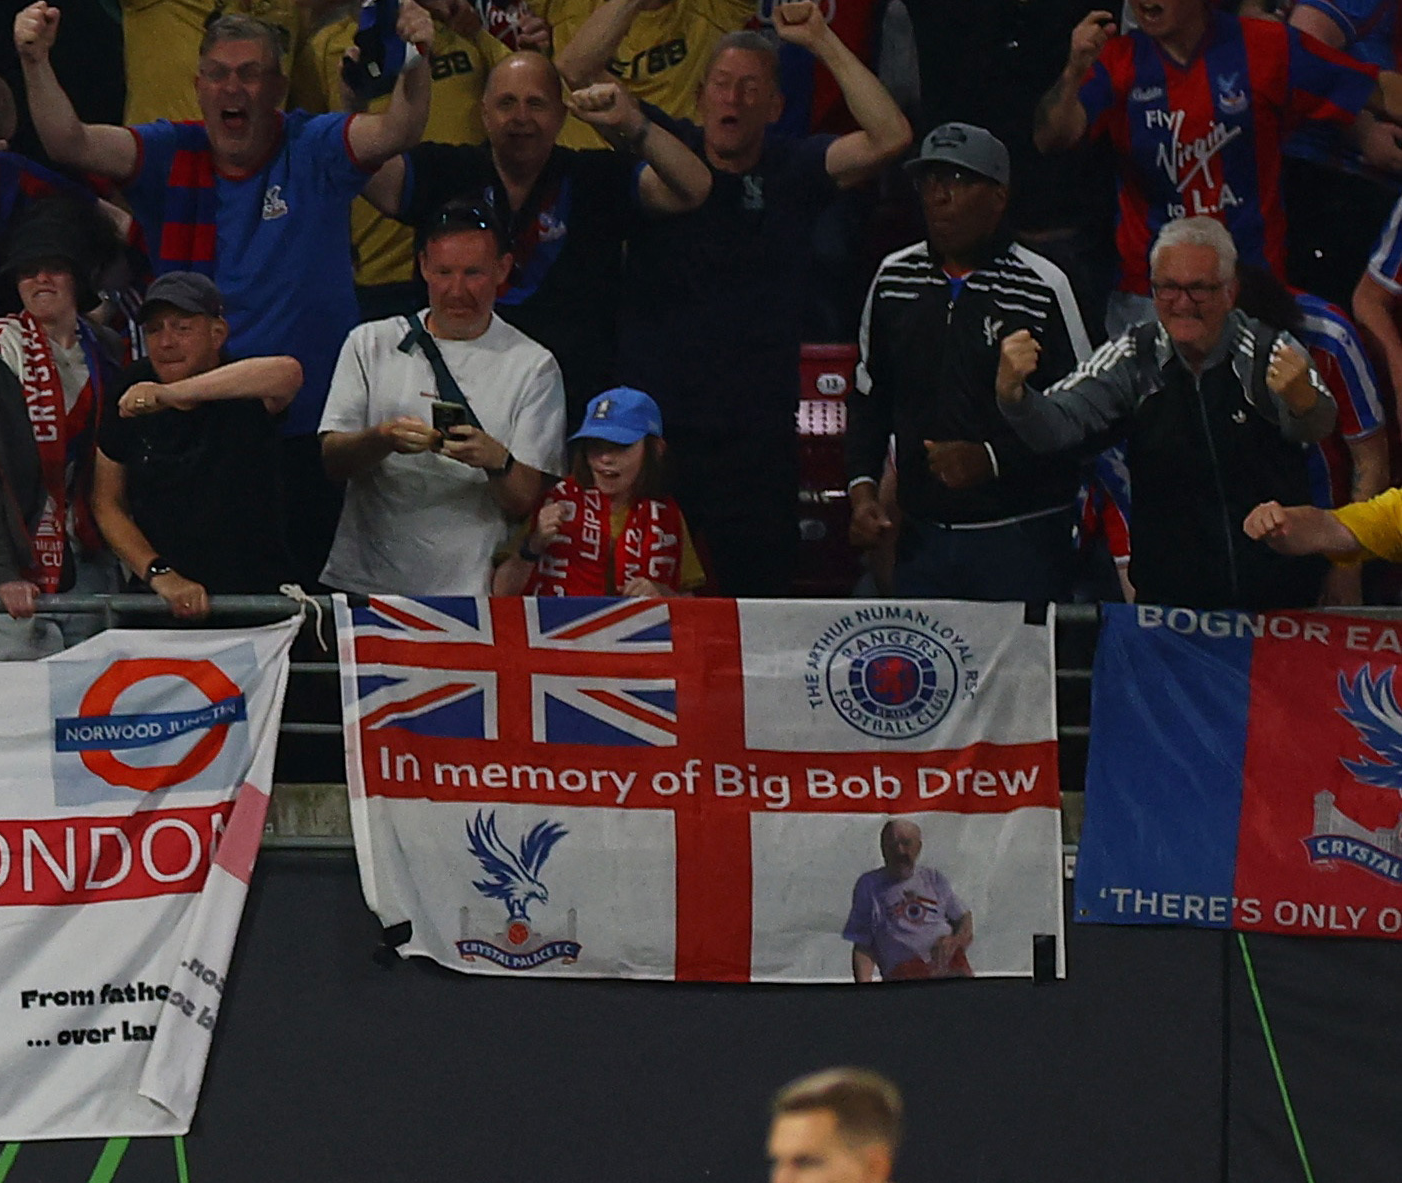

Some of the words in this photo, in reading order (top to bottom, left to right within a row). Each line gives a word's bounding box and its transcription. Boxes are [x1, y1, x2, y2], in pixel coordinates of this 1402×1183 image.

[854, 606, 930, 627] NUMAN
[1136, 604, 1330, 645] BOGNOR
[807, 616, 854, 671] ARTHUR
[929, 620, 974, 665] LOYAL
[804, 672, 824, 710] THE
[834, 689, 916, 734] FOOTBALL
[916, 688, 950, 726] CLUB
[65, 722, 162, 742] NORWOOD
[379, 745, 422, 783] In
[433, 758, 638, 804] memory
[651, 759, 702, 797] of
[712, 764, 792, 810] Big
[806, 765, 901, 801] Bob
[917, 765, 1040, 799] Drew
[1314, 839, 1402, 880] CRYSTAL
[1274, 899, 1367, 931] ONLY
[462, 942, 511, 965] CRYSTAL
[512, 947, 554, 967] PALACE
[20, 988, 95, 1009] From
[56, 1025, 116, 1047] over
